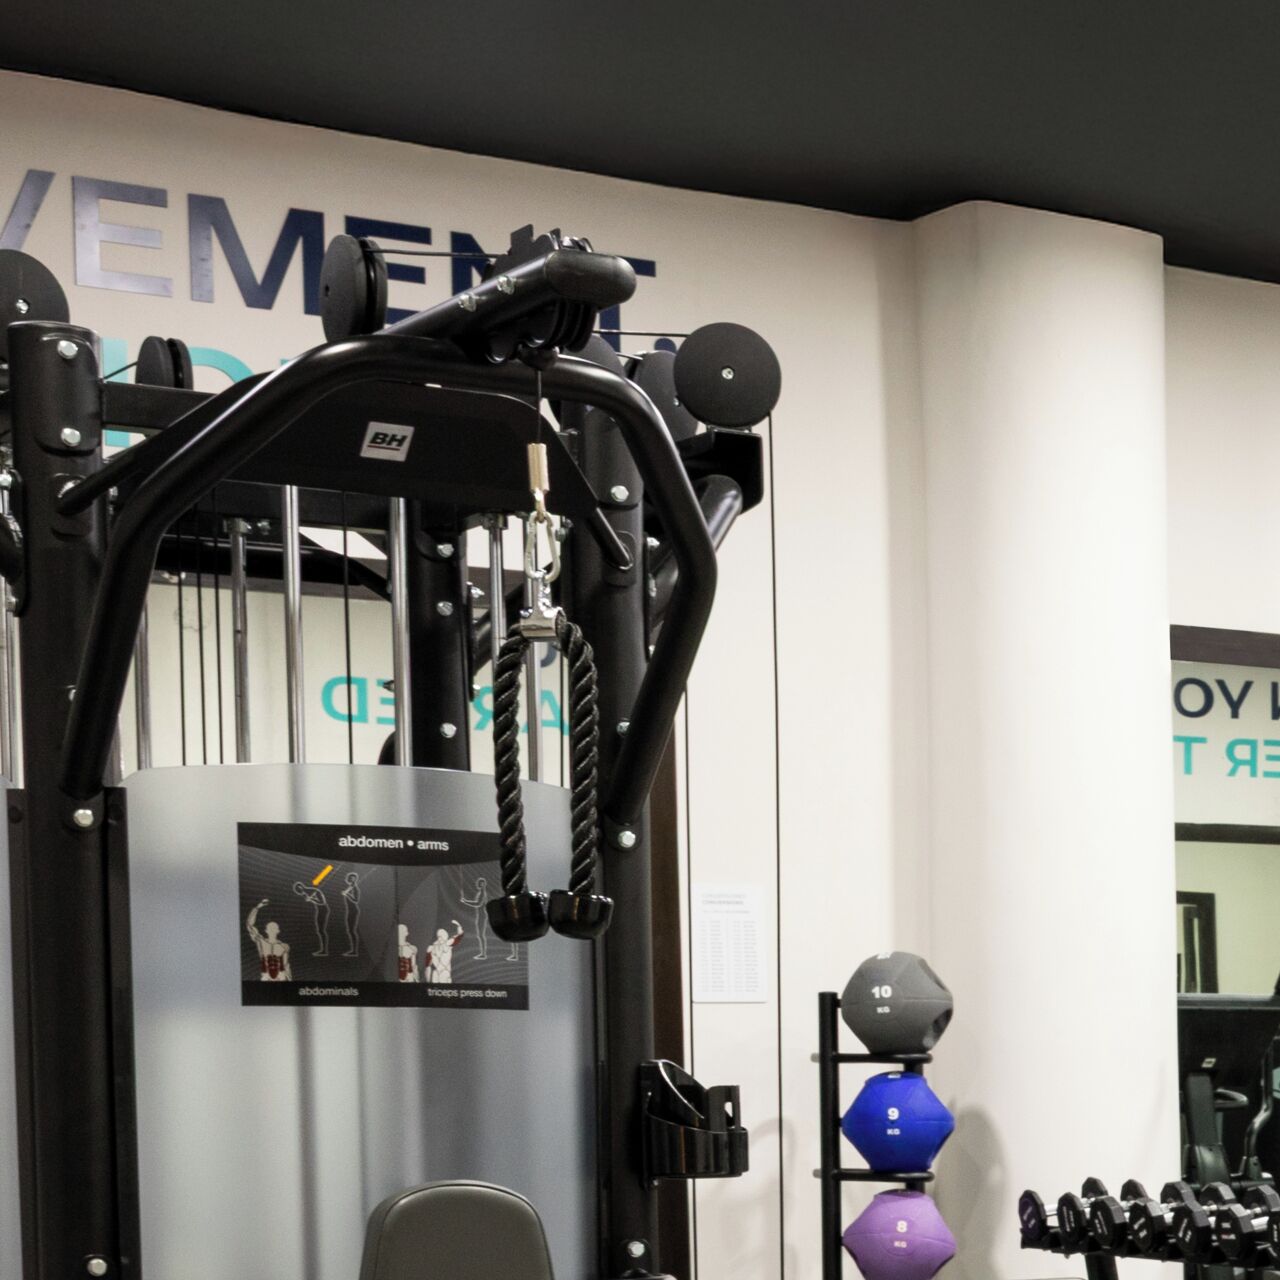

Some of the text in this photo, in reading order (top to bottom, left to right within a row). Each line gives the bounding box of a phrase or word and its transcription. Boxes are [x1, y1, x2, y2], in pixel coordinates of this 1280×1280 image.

[369, 431, 408, 447] BH
[338, 835, 450, 851] abdomen arms
[298, 986, 359, 997] abdominals
[427, 987, 507, 999] triceps press down
[871, 985, 892, 999] 10
[887, 1107, 900, 1120] 9
[896, 1220, 908, 1233] 8
